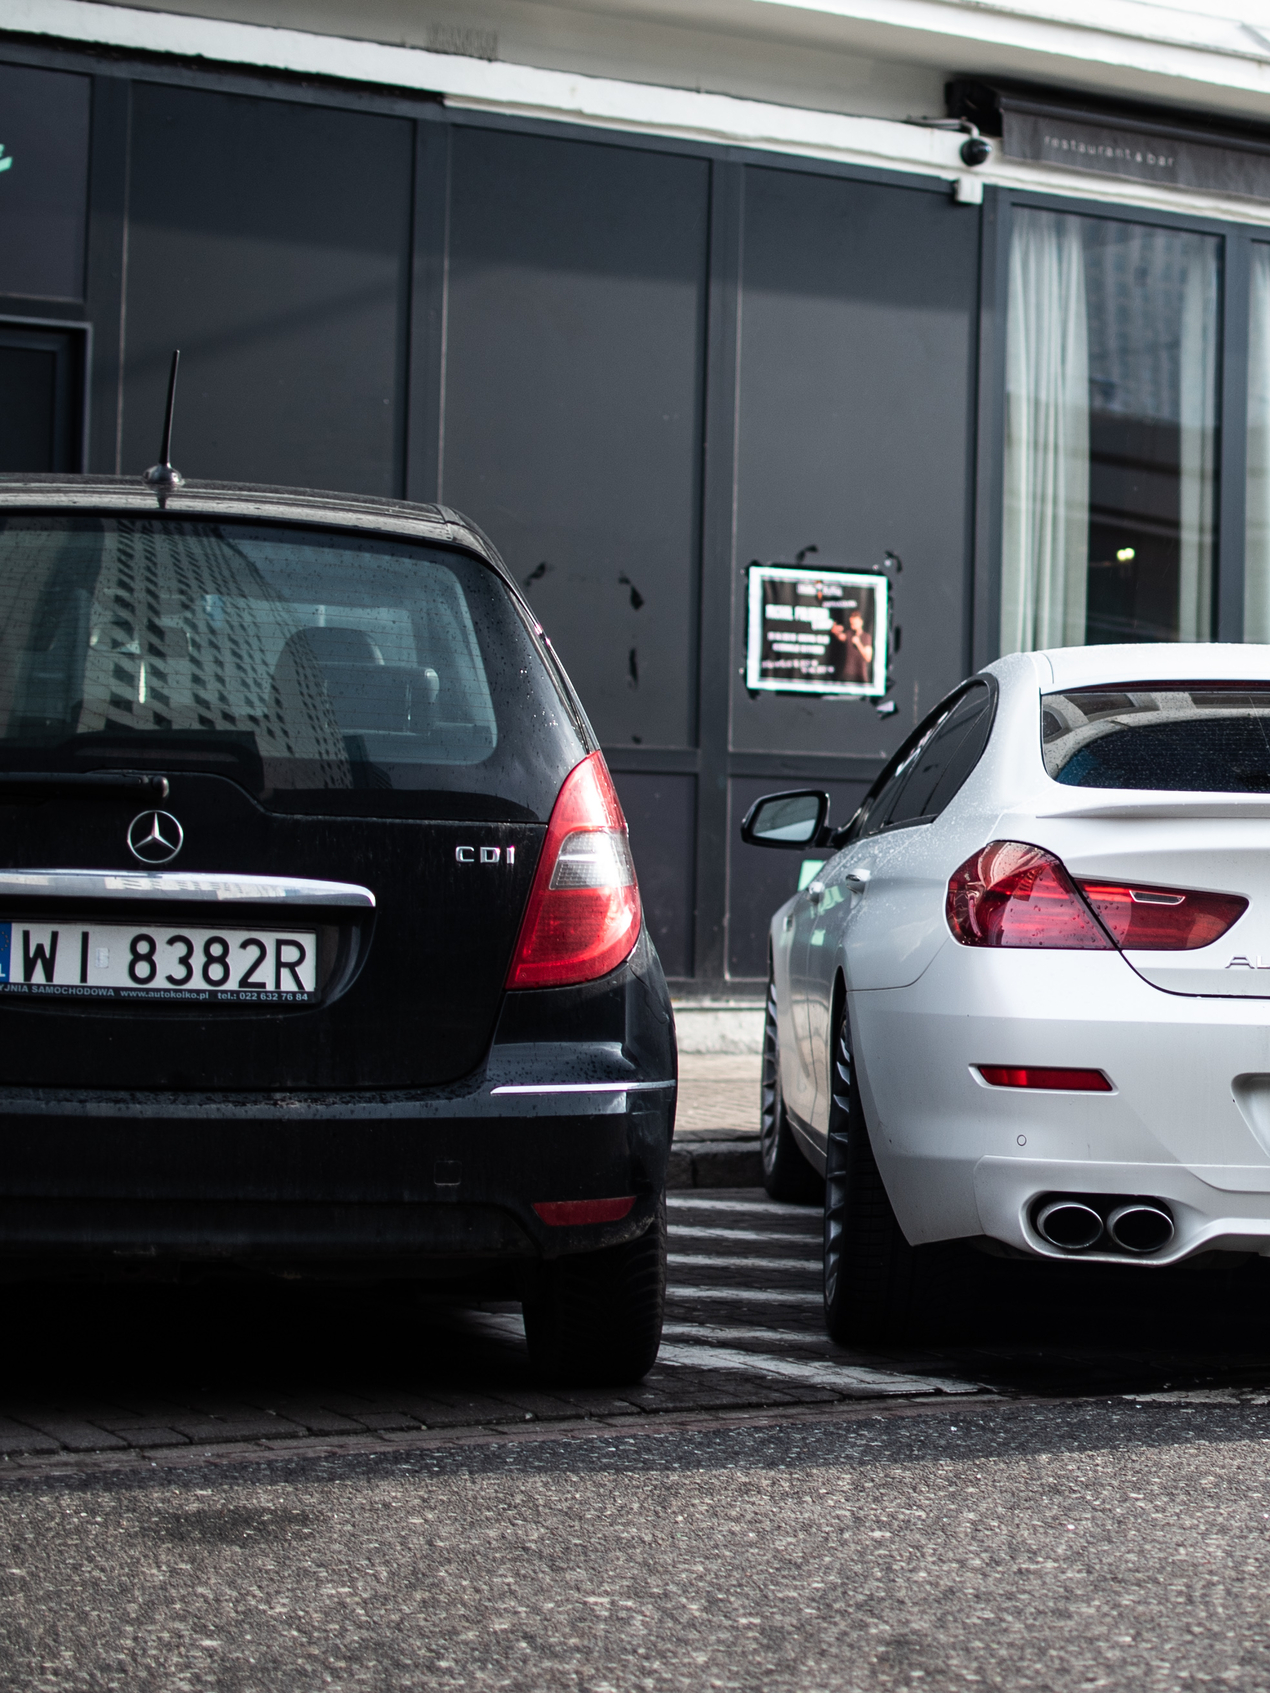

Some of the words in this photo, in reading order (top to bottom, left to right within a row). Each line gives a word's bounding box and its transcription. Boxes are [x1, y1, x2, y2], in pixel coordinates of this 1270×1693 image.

[1044, 135, 1131, 160] restaurant
[1146, 151, 1174, 167] bar
[455, 844, 515, 864] CDI
[22, 929, 90, 984] WI
[128, 932, 307, 992] 8382R
[31, 985, 115, 997] SAMOCHODOWA
[120, 989, 209, 1000] www.autokolko.pl
[239, 992, 258, 1001] 022
[260, 992, 279, 1001] 632
[281, 992, 293, 1001] 76
[295, 993, 308, 1002] 84
